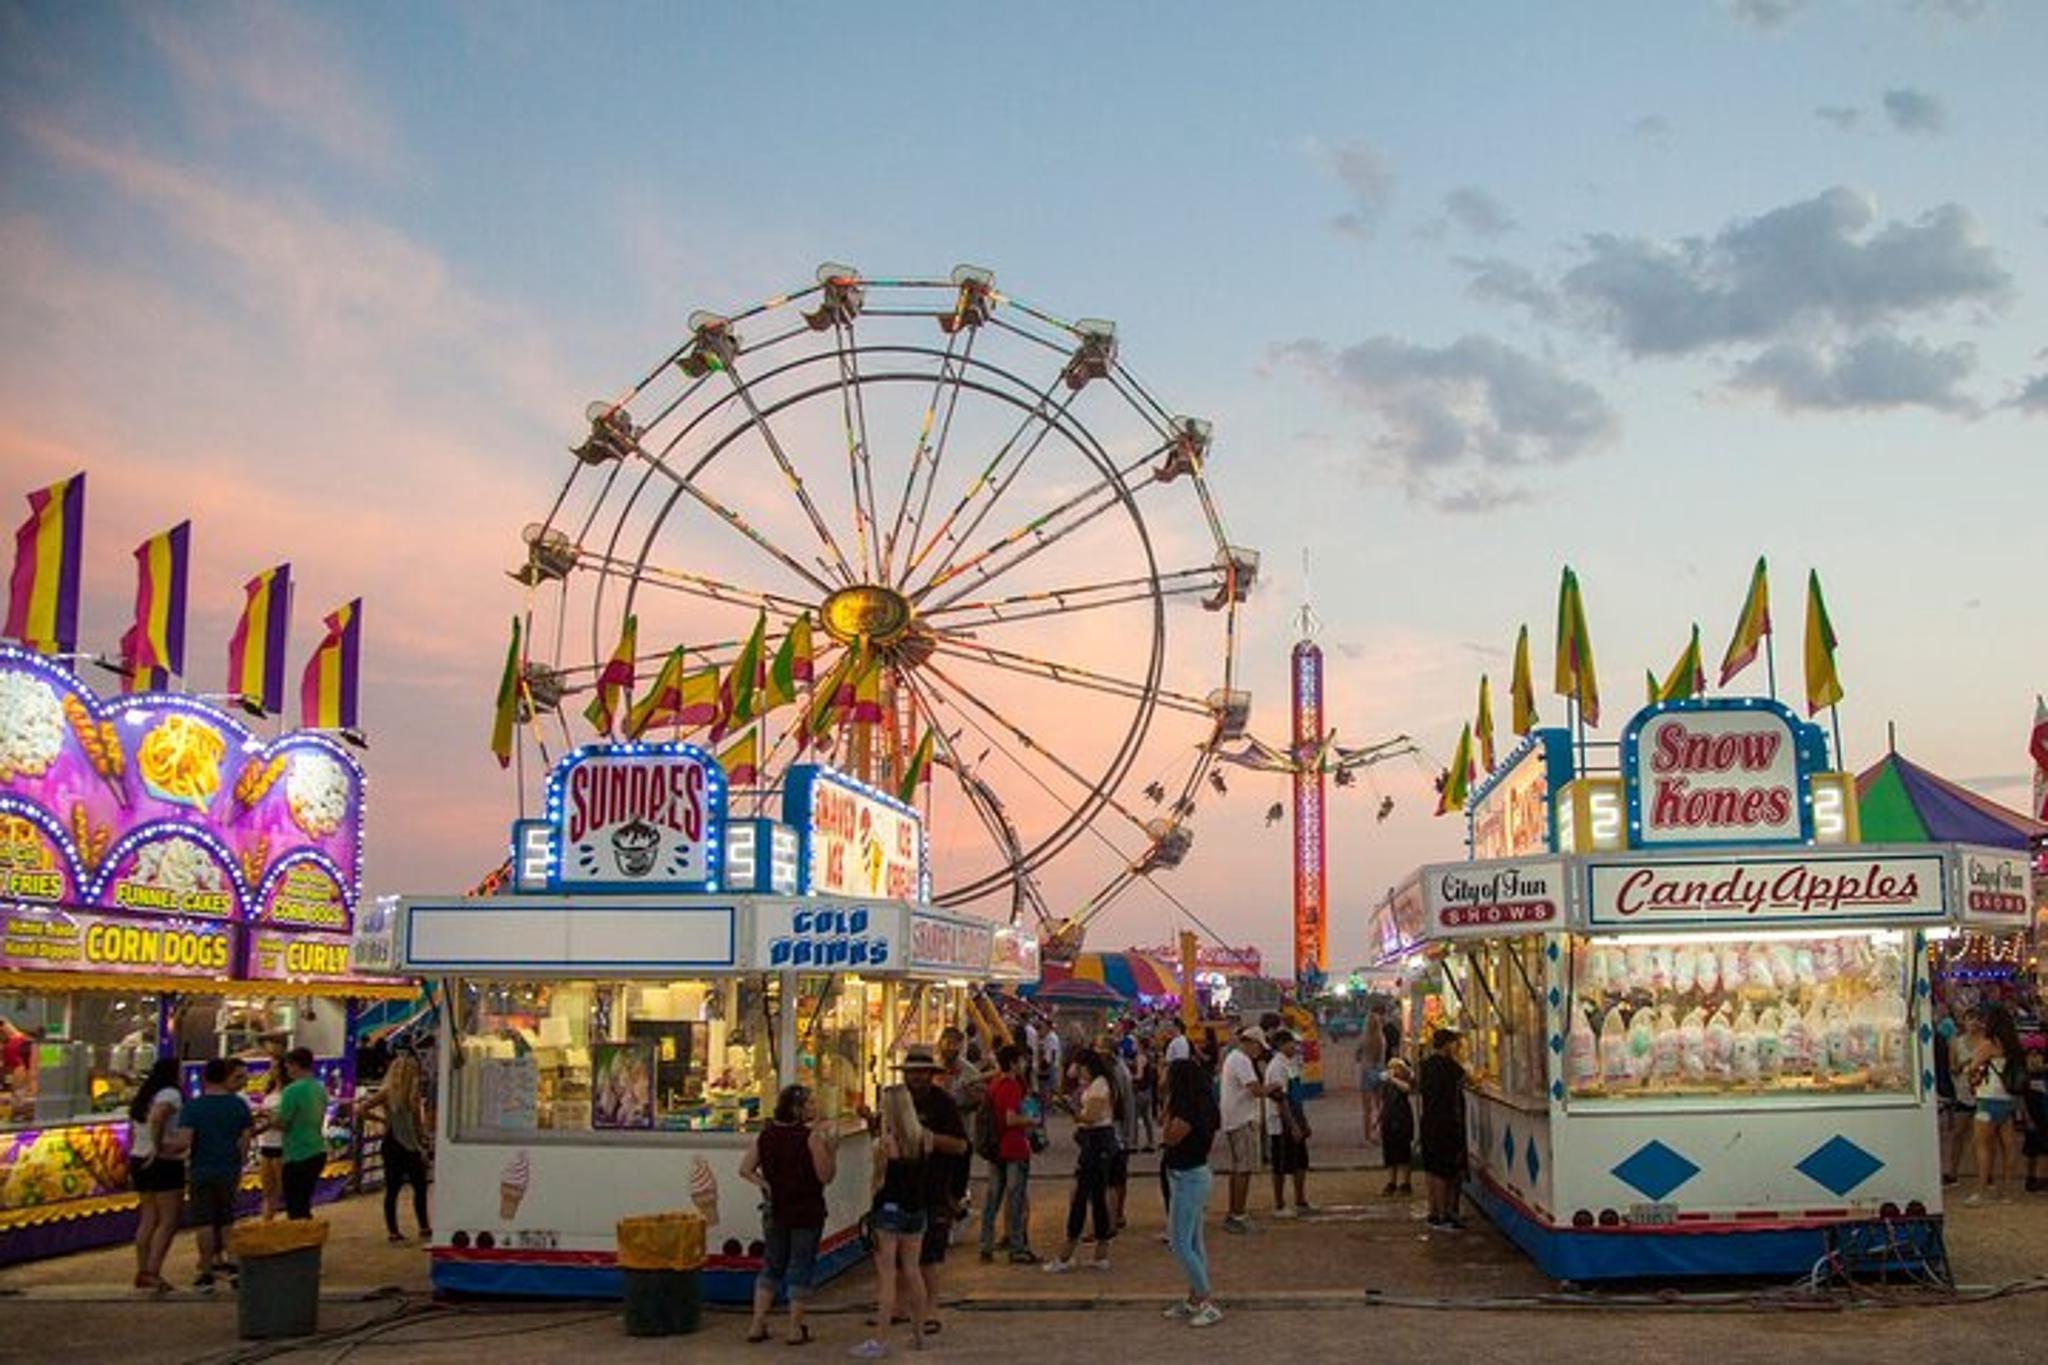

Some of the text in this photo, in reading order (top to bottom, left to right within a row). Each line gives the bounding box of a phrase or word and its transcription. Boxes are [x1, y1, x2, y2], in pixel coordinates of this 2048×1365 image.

[1653, 722, 1781, 773] Snow
[570, 764, 703, 843] SUNDAES
[1651, 776, 1792, 829] Kones
[9, 872, 61, 898] FRIES
[115, 882, 231, 916] FUNNEL CAKES
[1442, 868, 1547, 907] City of Fun
[1617, 863, 1920, 915] Candy Apples
[792, 908, 868, 934] COLD
[86, 922, 230, 969] CORN DOGS
[286, 941, 349, 975] CURLY
[770, 938, 889, 966] DRINKS
